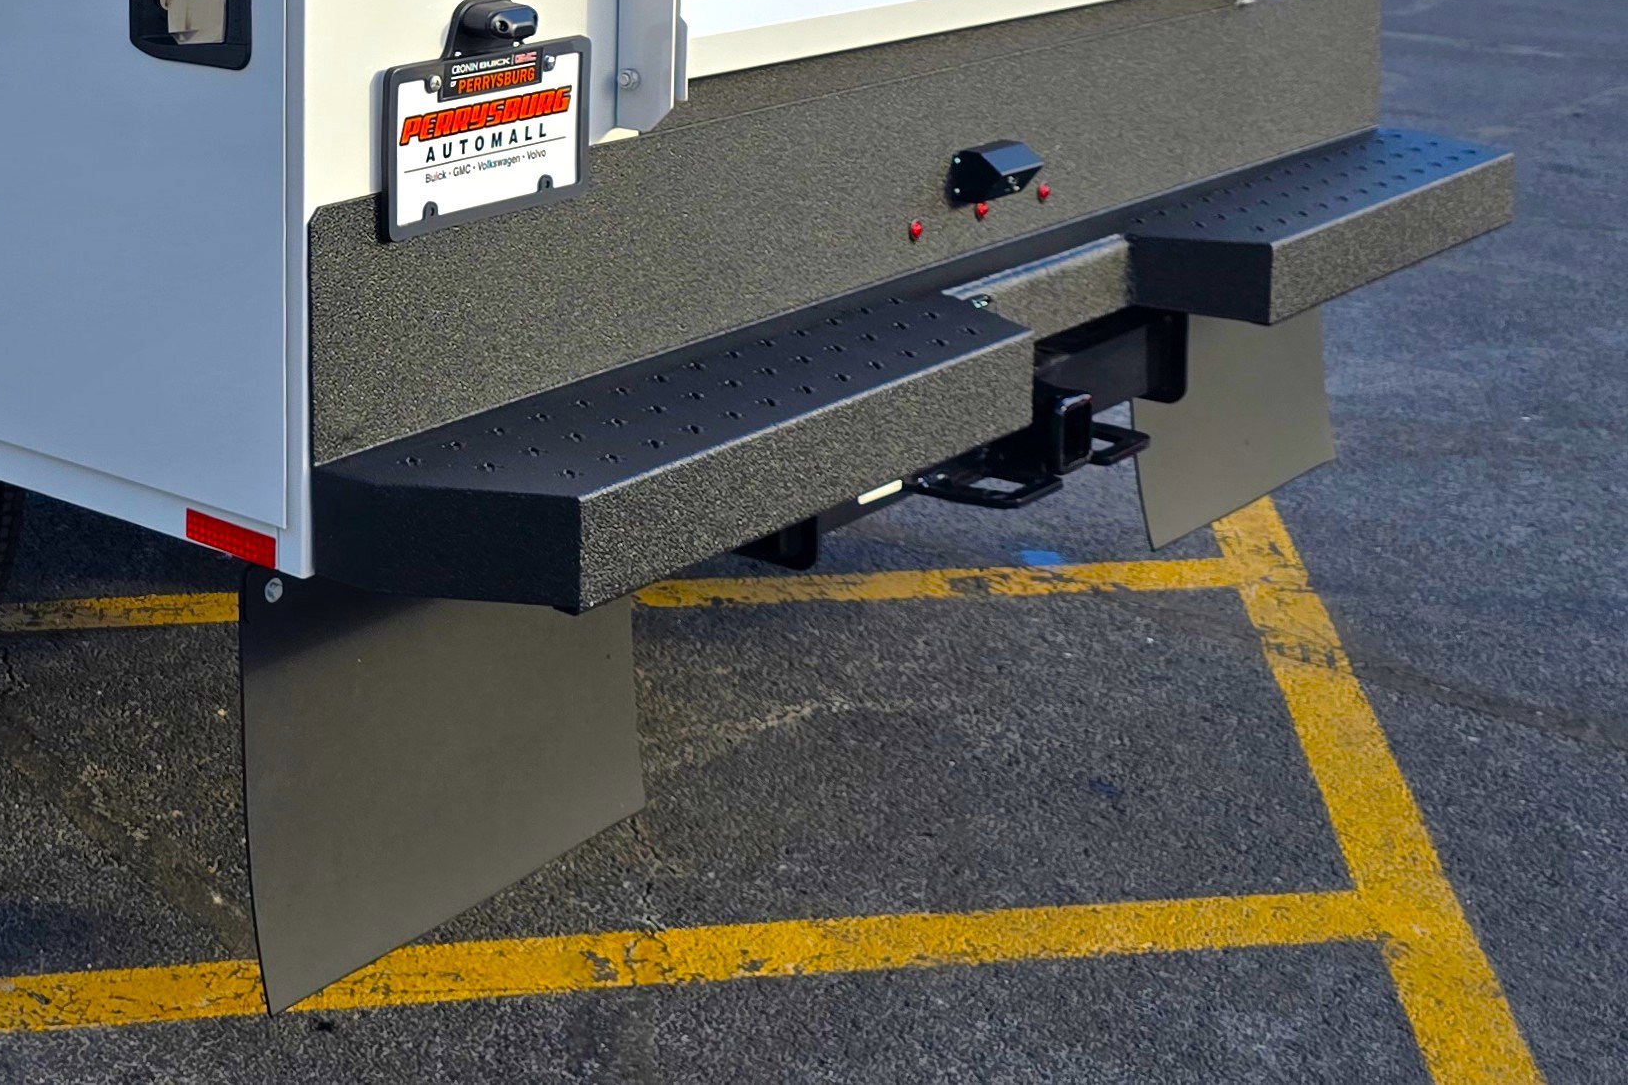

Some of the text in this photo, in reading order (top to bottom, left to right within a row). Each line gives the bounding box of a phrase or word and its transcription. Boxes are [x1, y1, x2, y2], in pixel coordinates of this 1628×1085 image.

[452, 62, 478, 75] CRONIN
[479, 57, 511, 70] BUICK
[457, 67, 536, 95] PERRYSBURG
[399, 85, 572, 146] PERRYSBURG
[425, 123, 547, 163] AUTOMALL
[425, 148, 547, 183] Buick GMC Volkswagen Volvo
